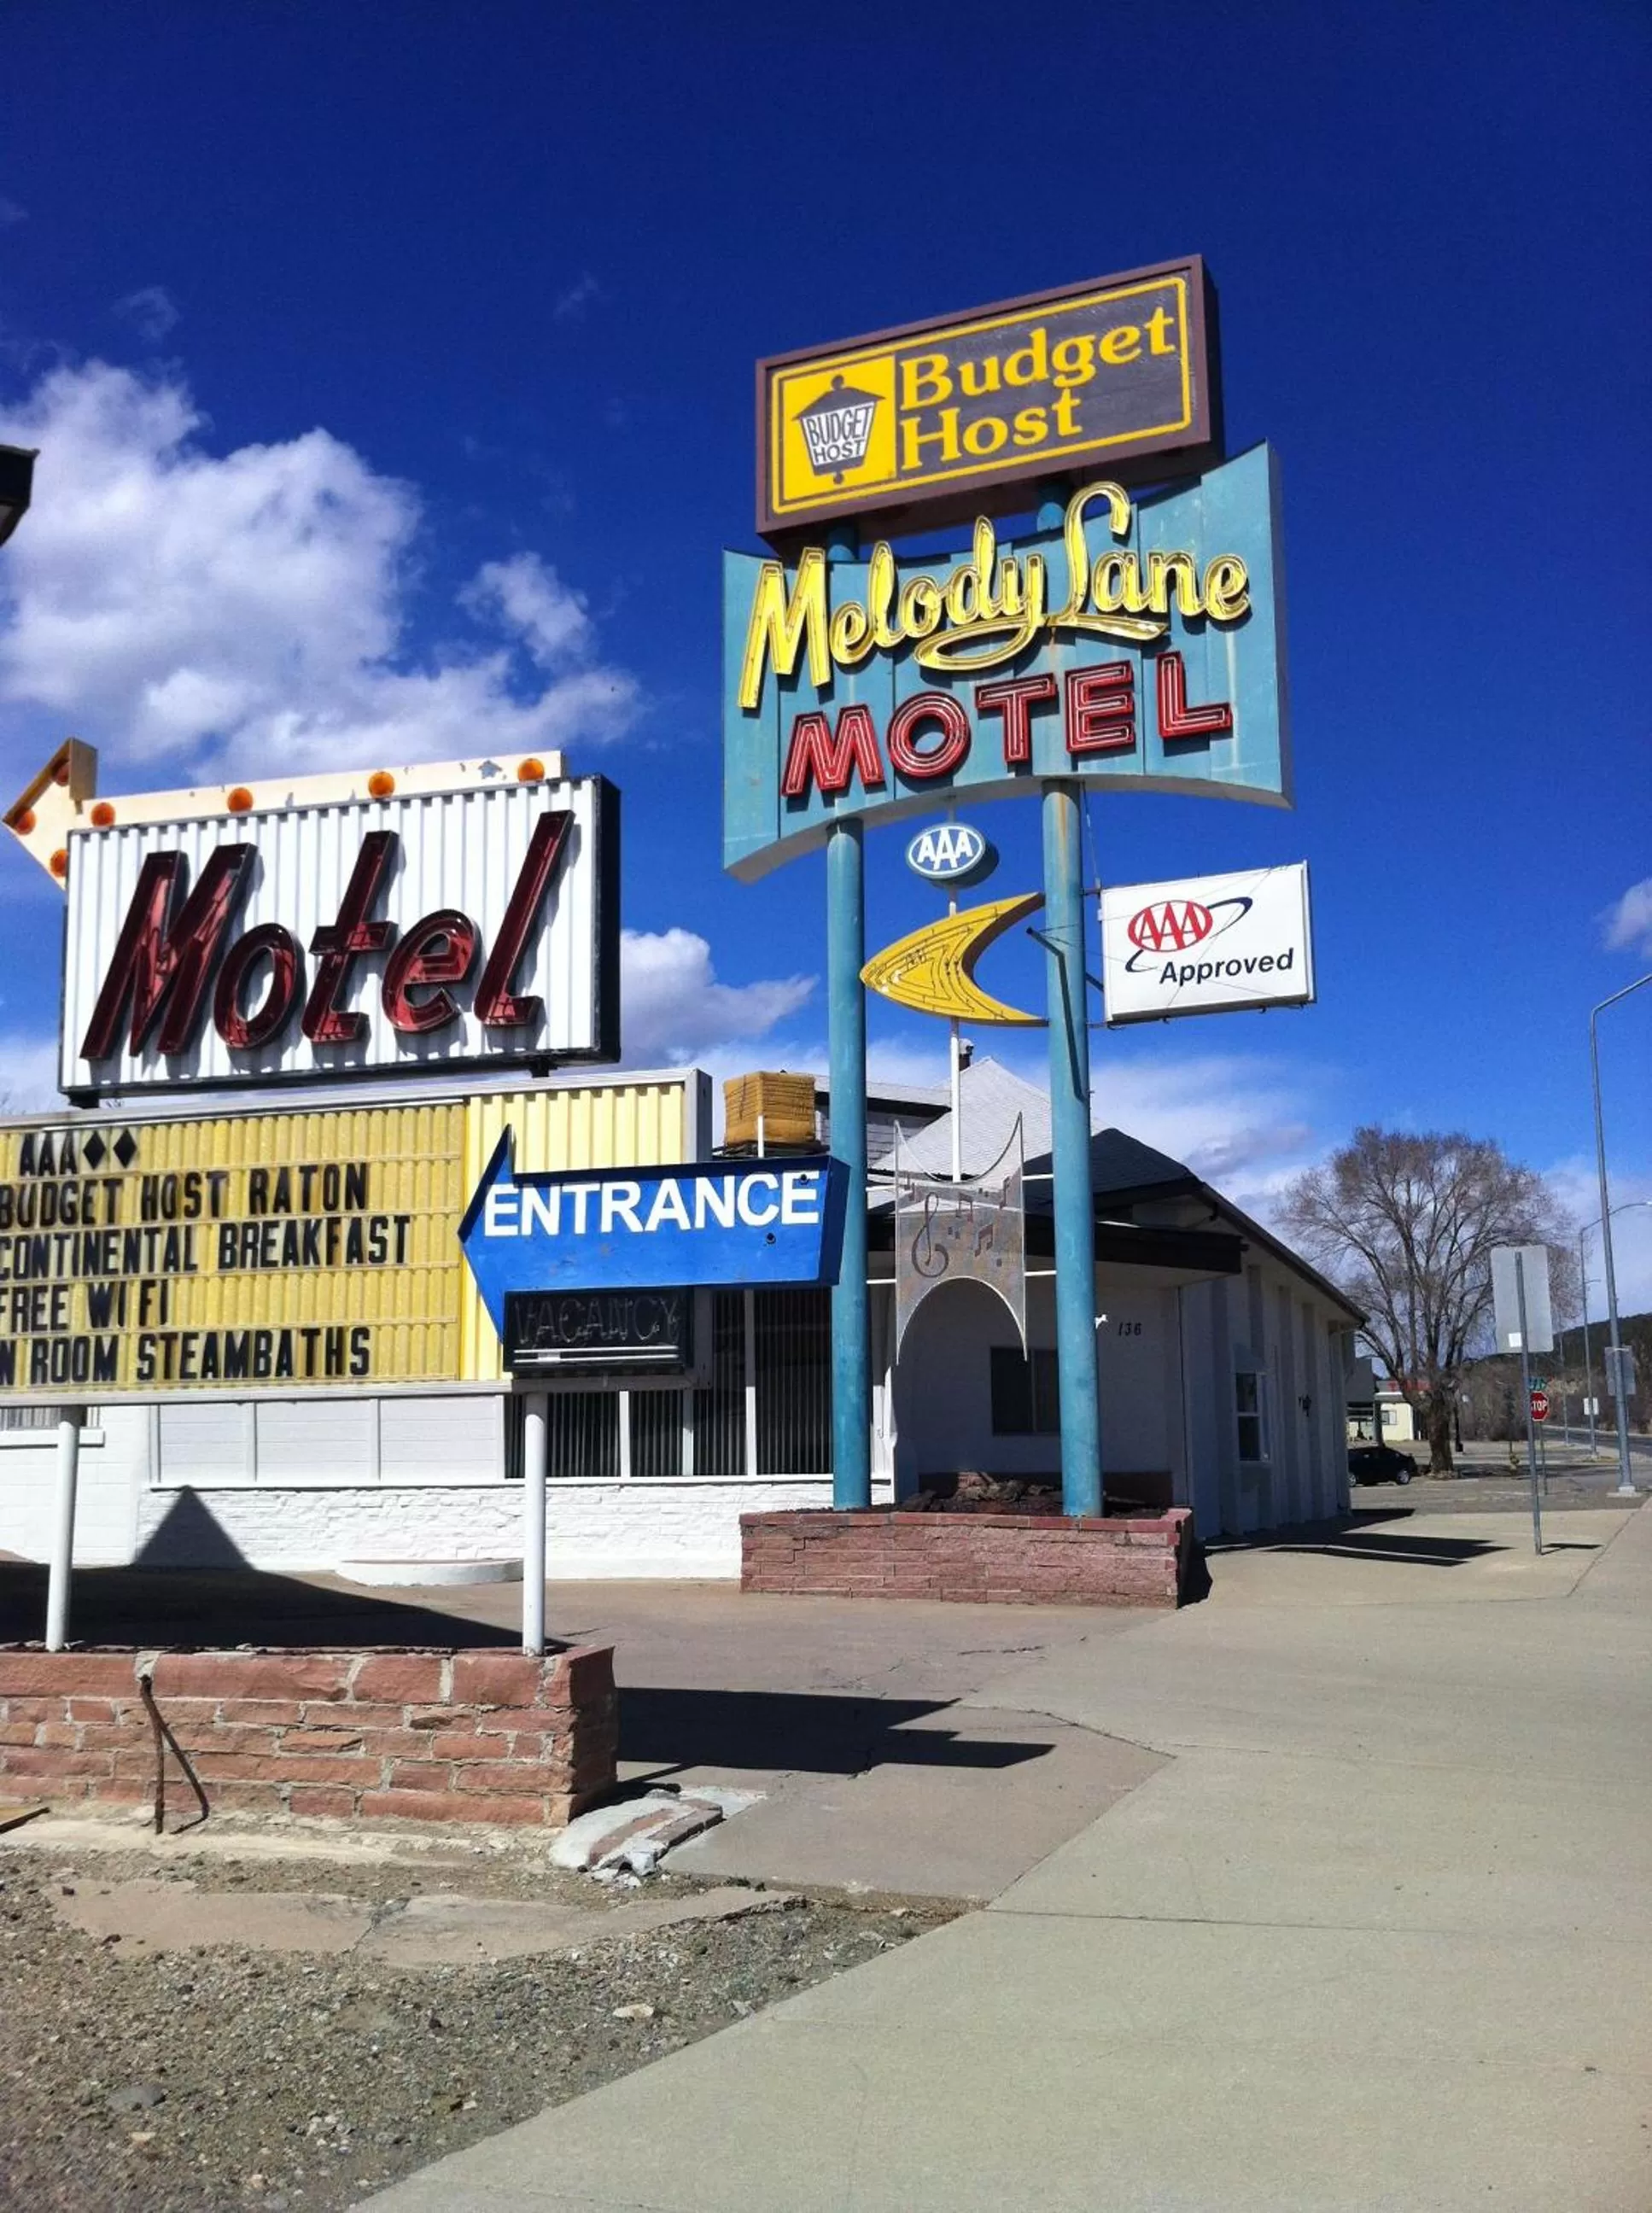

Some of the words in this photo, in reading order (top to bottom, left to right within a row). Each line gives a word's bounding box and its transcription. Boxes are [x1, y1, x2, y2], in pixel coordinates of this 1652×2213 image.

[899, 307, 1175, 412] Budget
[806, 406, 871, 447] BUDGET
[814, 439, 865, 463] HOST
[899, 387, 1083, 471] Host
[738, 515, 1045, 708] Melody
[1047, 481, 1251, 641] Lane
[781, 651, 1233, 797] MOTEL
[916, 828, 973, 868] AAA
[80, 809, 575, 1060] Motel
[1135, 902, 1206, 951] AAA
[1159, 948, 1293, 986] Approved
[20, 1131, 78, 1177] AAA
[0, 1179, 123, 1229] BUDGET
[141, 1171, 227, 1221] HOST
[249, 1162, 367, 1213] RATON
[483, 1171, 820, 1237] ENTRANCE
[0, 1225, 198, 1281] CONTINENTAL
[219, 1216, 411, 1270] BREAKFAST
[515, 1295, 682, 1345] VACANCY
[31, 1335, 120, 1385] ROOM
[137, 1326, 370, 1380] STEAMBATHS
[1530, 1399, 1547, 1411] TOP
